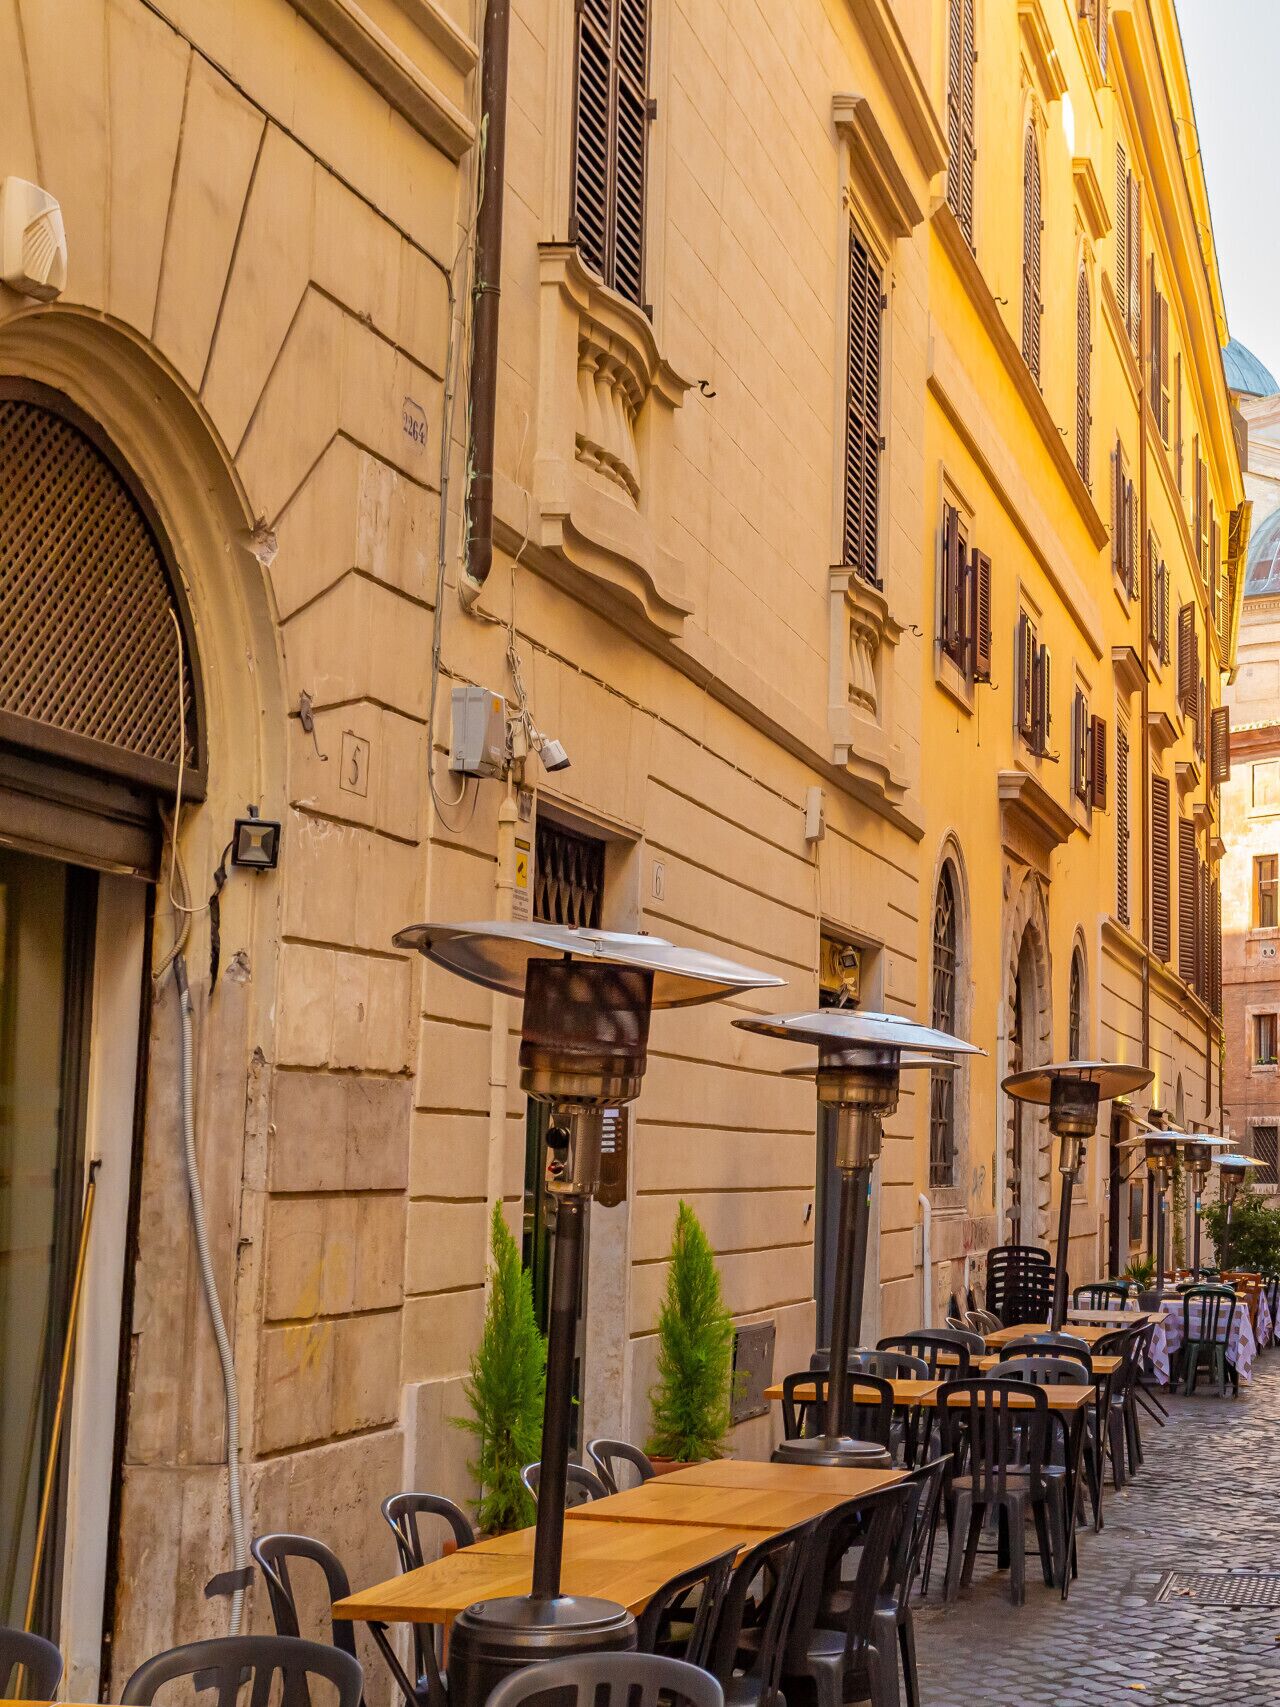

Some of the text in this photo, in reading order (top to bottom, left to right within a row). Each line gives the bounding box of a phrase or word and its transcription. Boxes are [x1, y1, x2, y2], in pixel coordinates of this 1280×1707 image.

[403, 411, 425, 445] 2264
[348, 744, 361, 786] 5
[655, 864, 663, 897] 6
